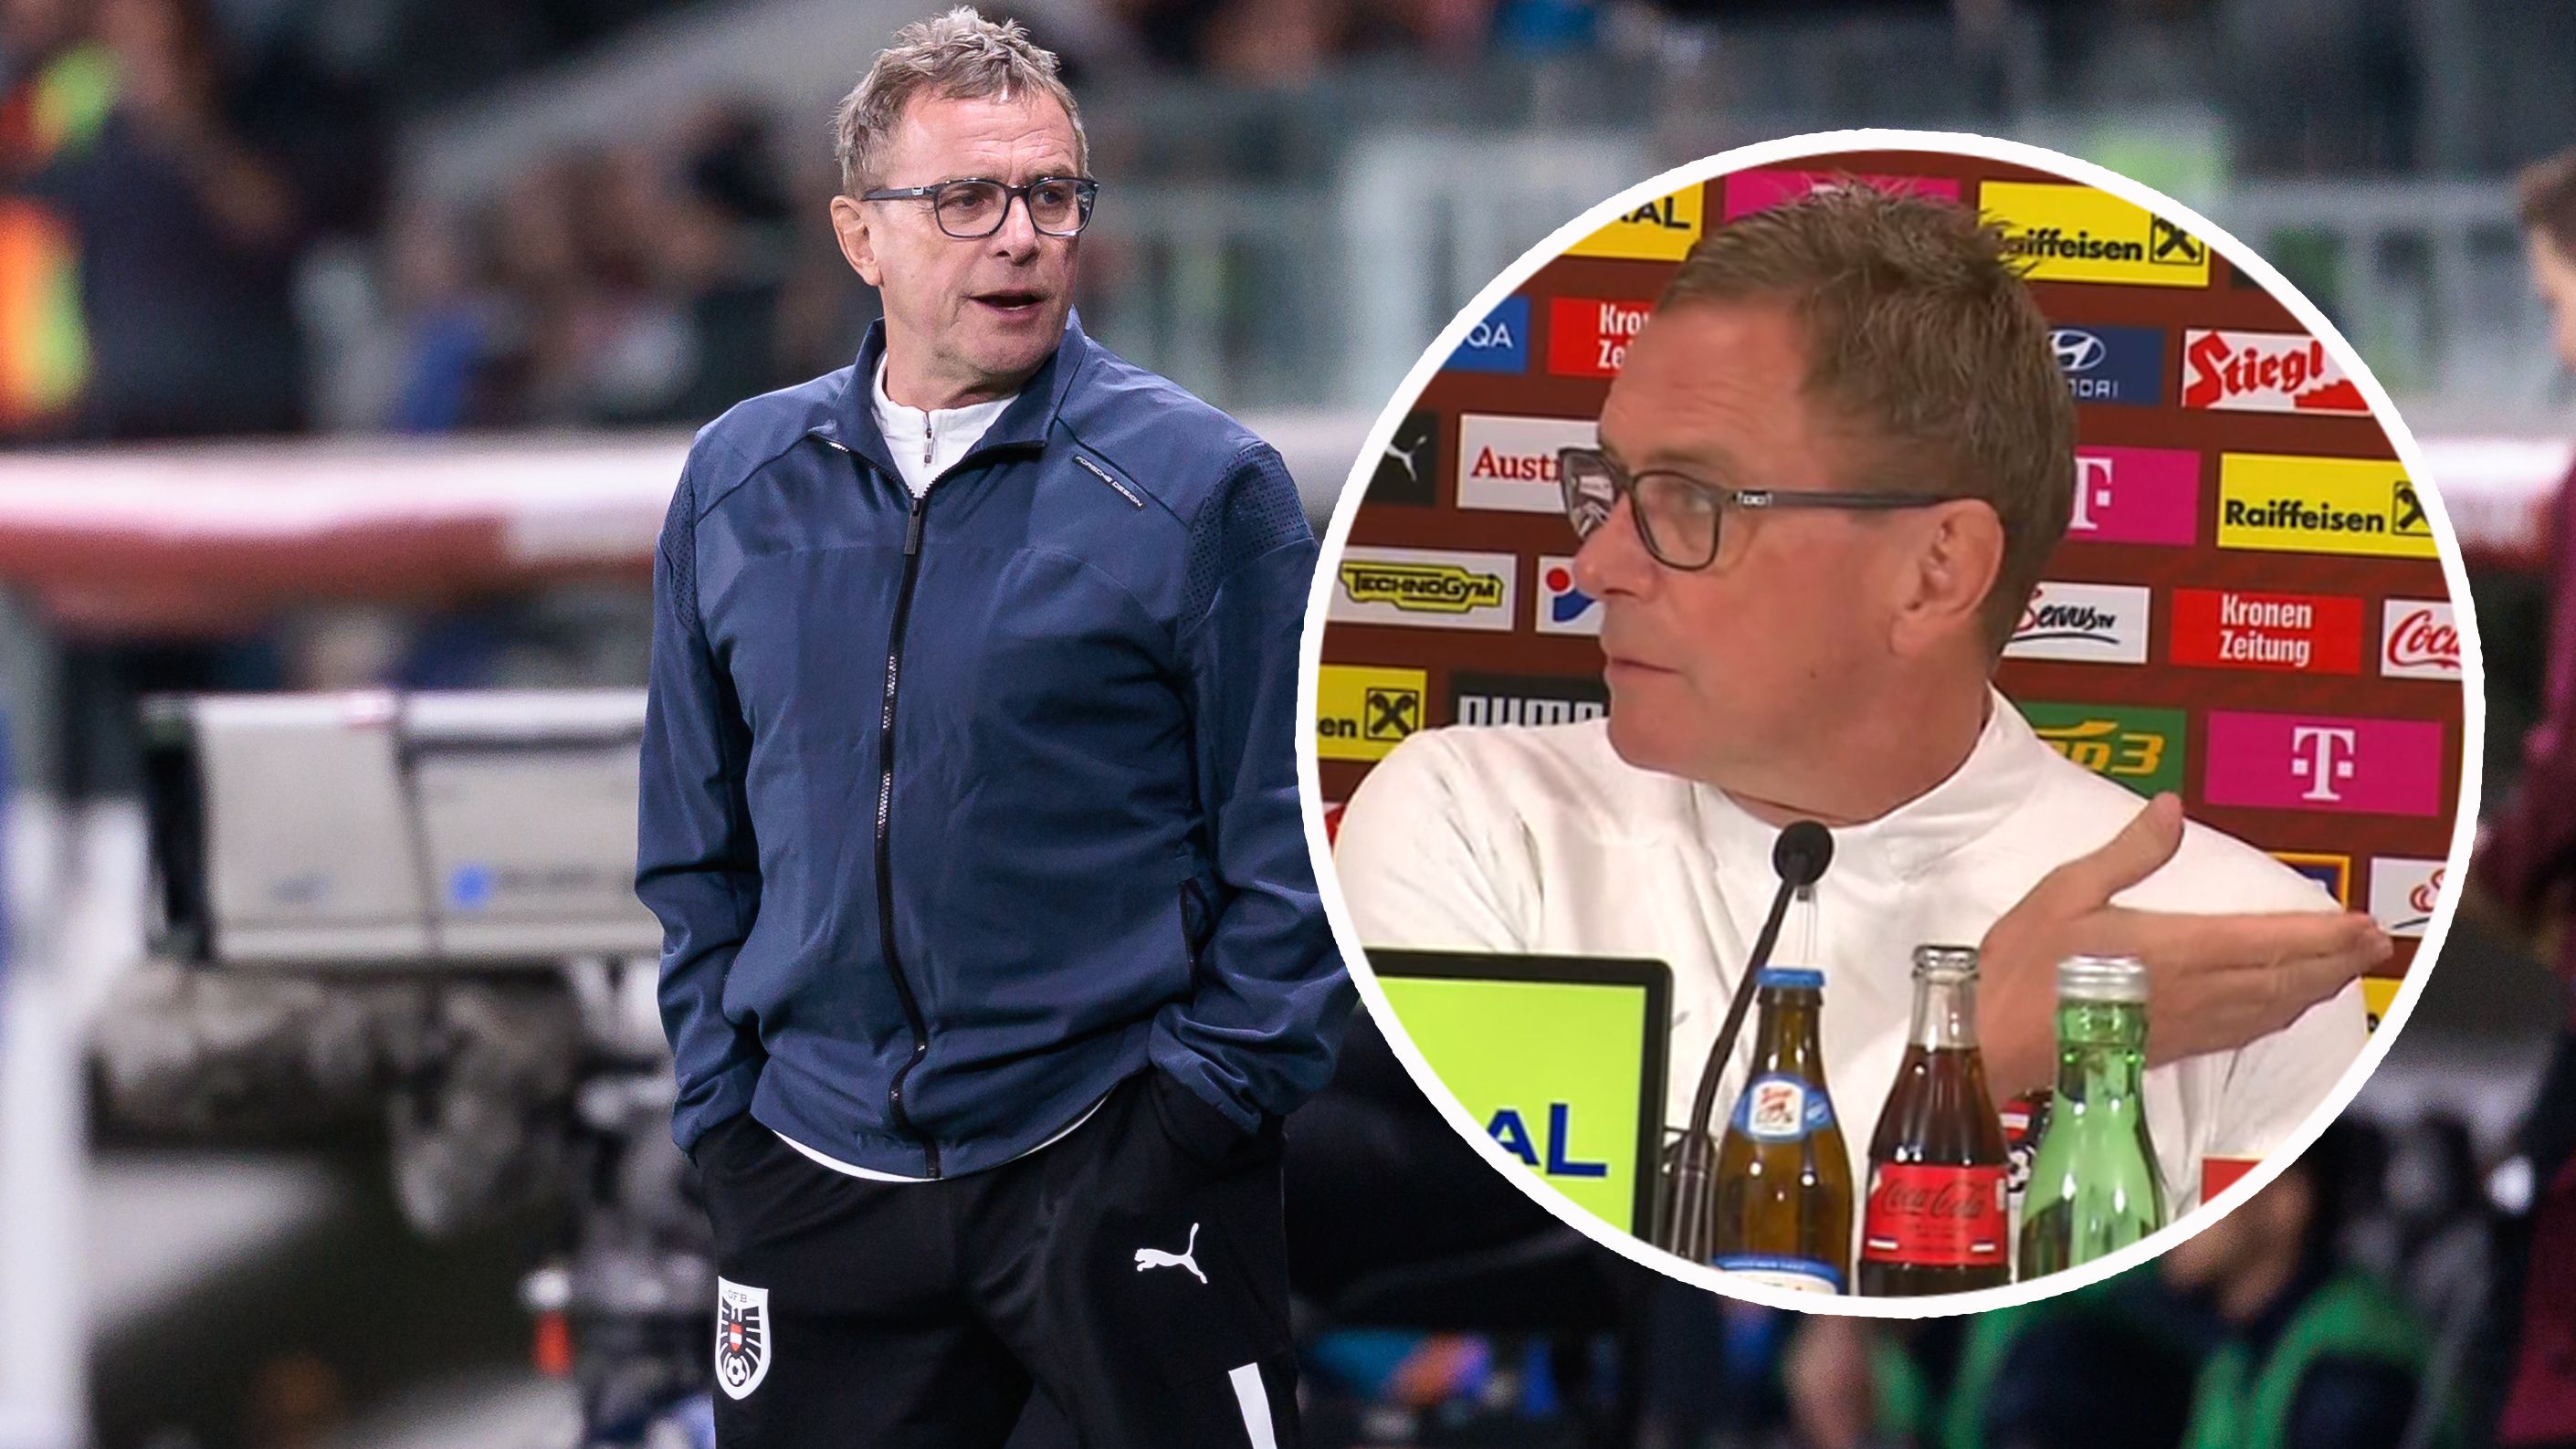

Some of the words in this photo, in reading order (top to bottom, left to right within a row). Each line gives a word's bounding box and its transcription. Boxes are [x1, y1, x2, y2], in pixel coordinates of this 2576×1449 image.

[1621, 194, 1692, 229] AL
[1996, 228, 2143, 261] aiffeisen
[1599, 302, 1650, 336] Kro
[1598, 339, 1633, 369] Ze
[2185, 331, 2324, 408] Stiegl
[1111, 480, 1143, 508] DESIGN
[2225, 499, 2385, 533] Raiffeisen
[2220, 593, 2312, 628] Kronen
[2219, 629, 2310, 668] Zeitung
[1317, 717, 1358, 738] en
